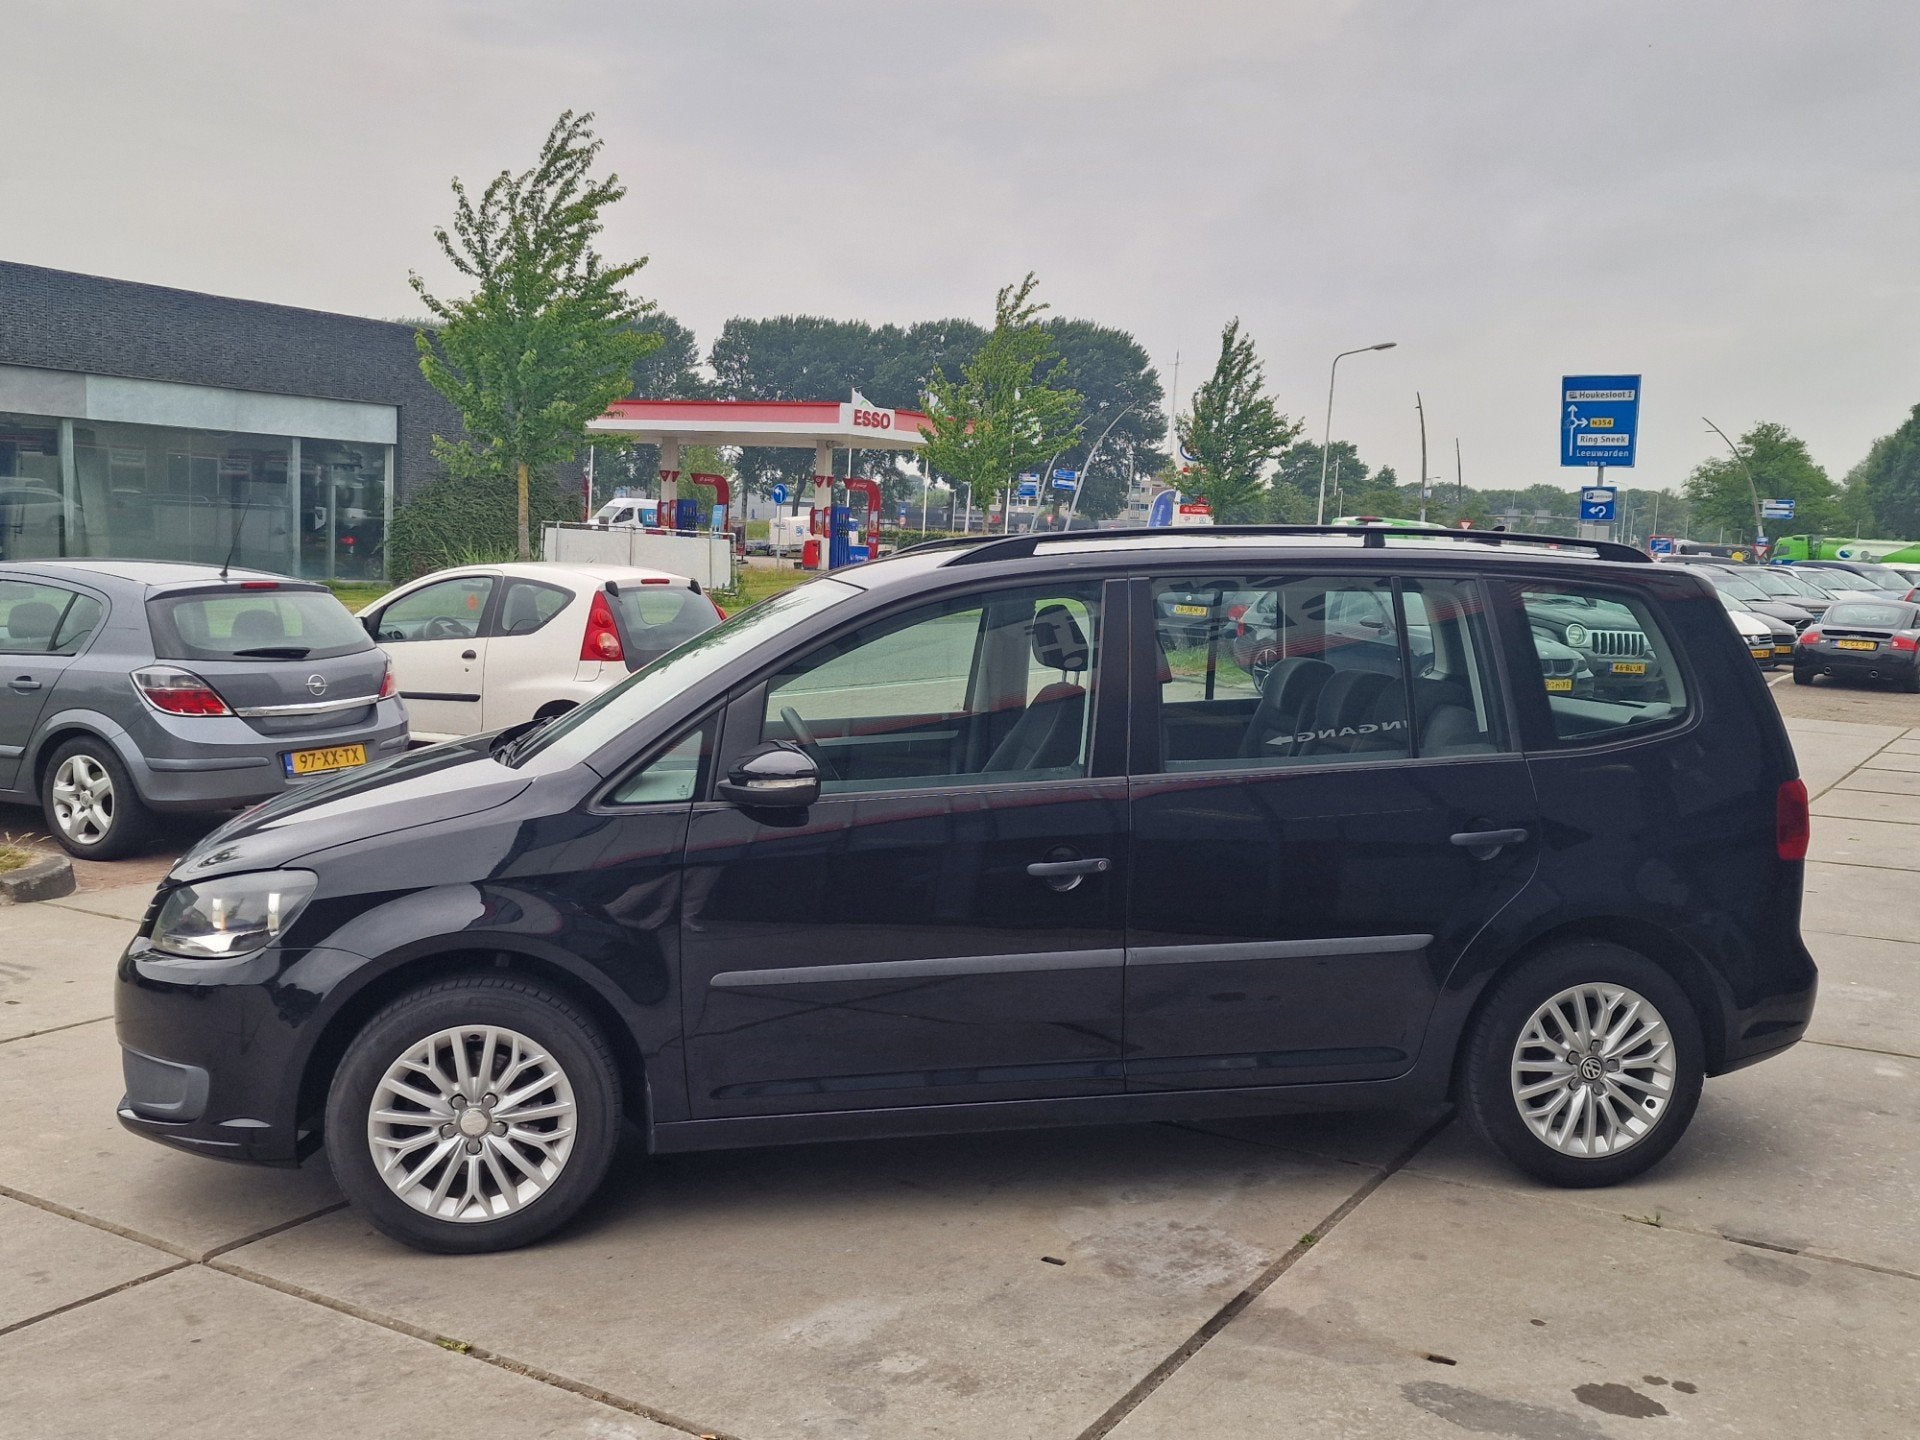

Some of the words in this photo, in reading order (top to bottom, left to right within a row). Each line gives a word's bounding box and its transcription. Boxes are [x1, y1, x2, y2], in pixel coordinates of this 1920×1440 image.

[1578, 390, 1625, 399] Houkesloot
[853, 408, 891, 429] ESSO
[1591, 418, 1612, 426] N354
[1580, 435, 1598, 444] Ring
[1601, 435, 1626, 443] Sneek
[300, 747, 360, 769] 97-XX-TX
